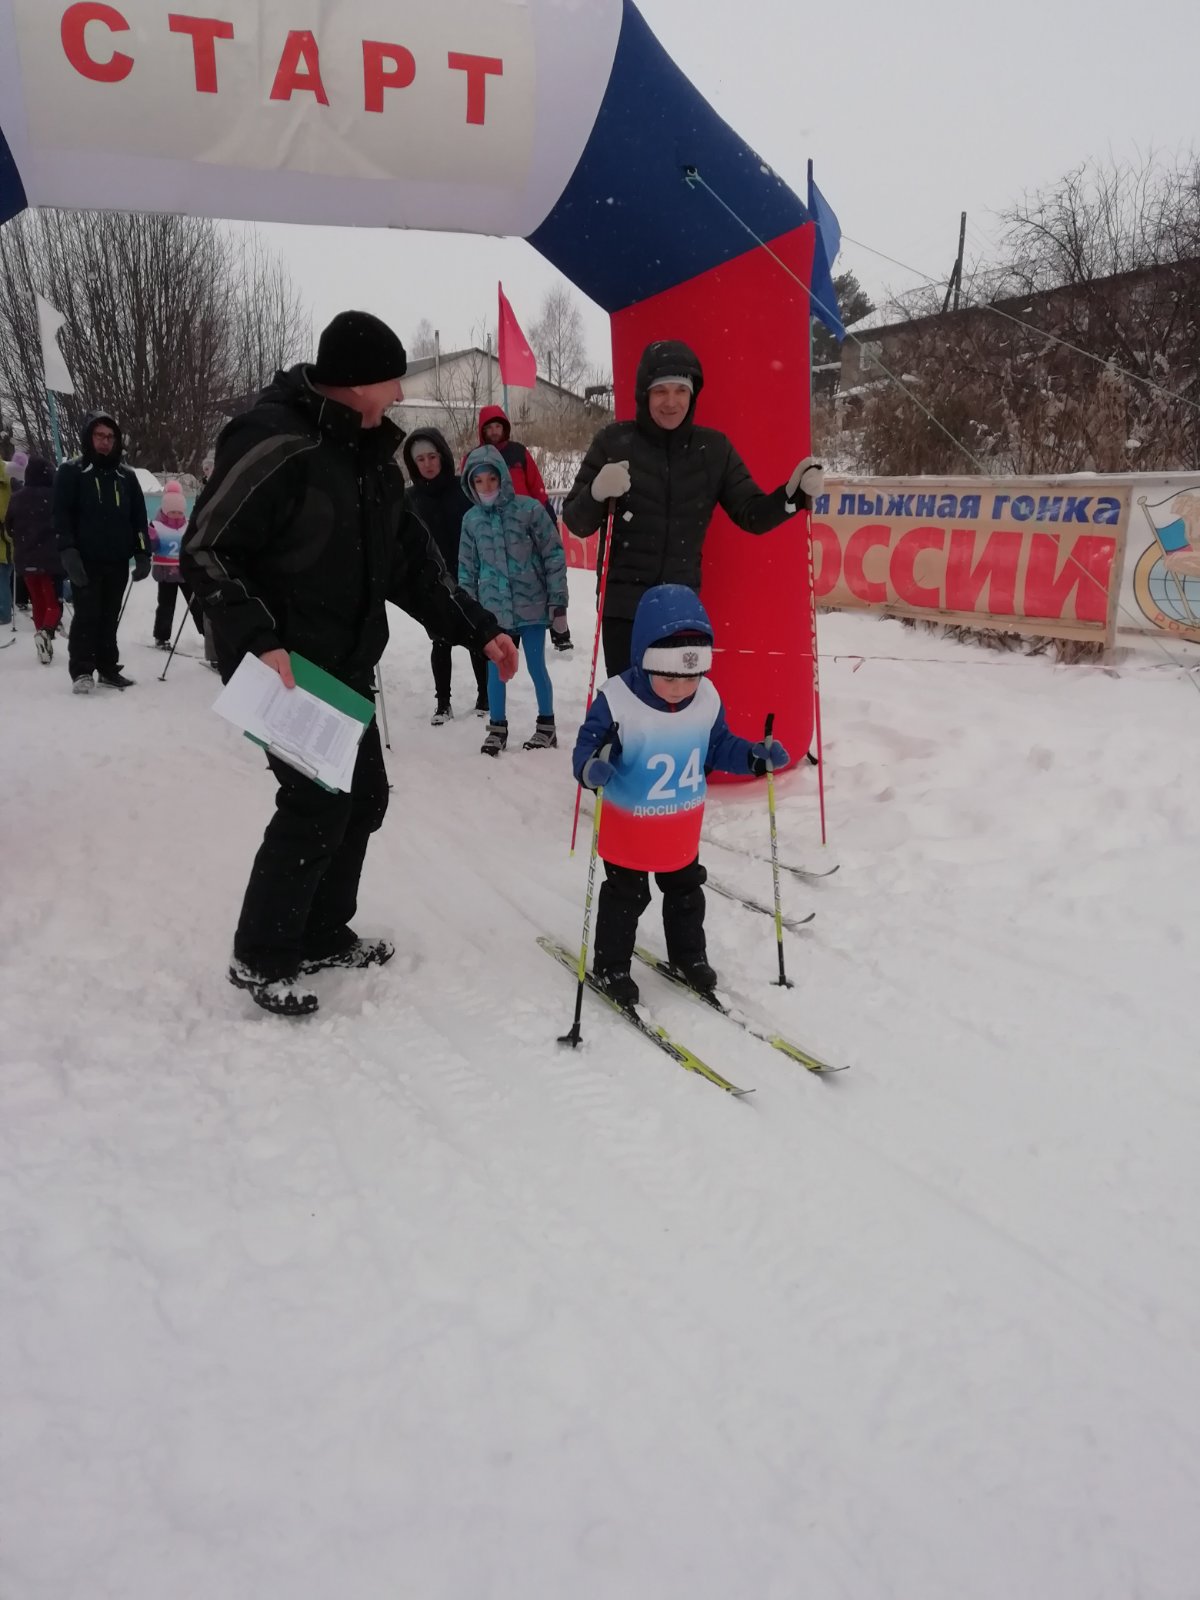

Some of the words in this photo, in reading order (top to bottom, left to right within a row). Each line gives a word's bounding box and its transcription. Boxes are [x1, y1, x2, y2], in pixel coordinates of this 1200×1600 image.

[60, 1, 503, 126] СТАРТ
[837, 493, 982, 519] лыжная
[991, 494, 1121, 525] гонка
[646, 747, 703, 801] 24
[633, 804, 678, 818] ДЮСШ
